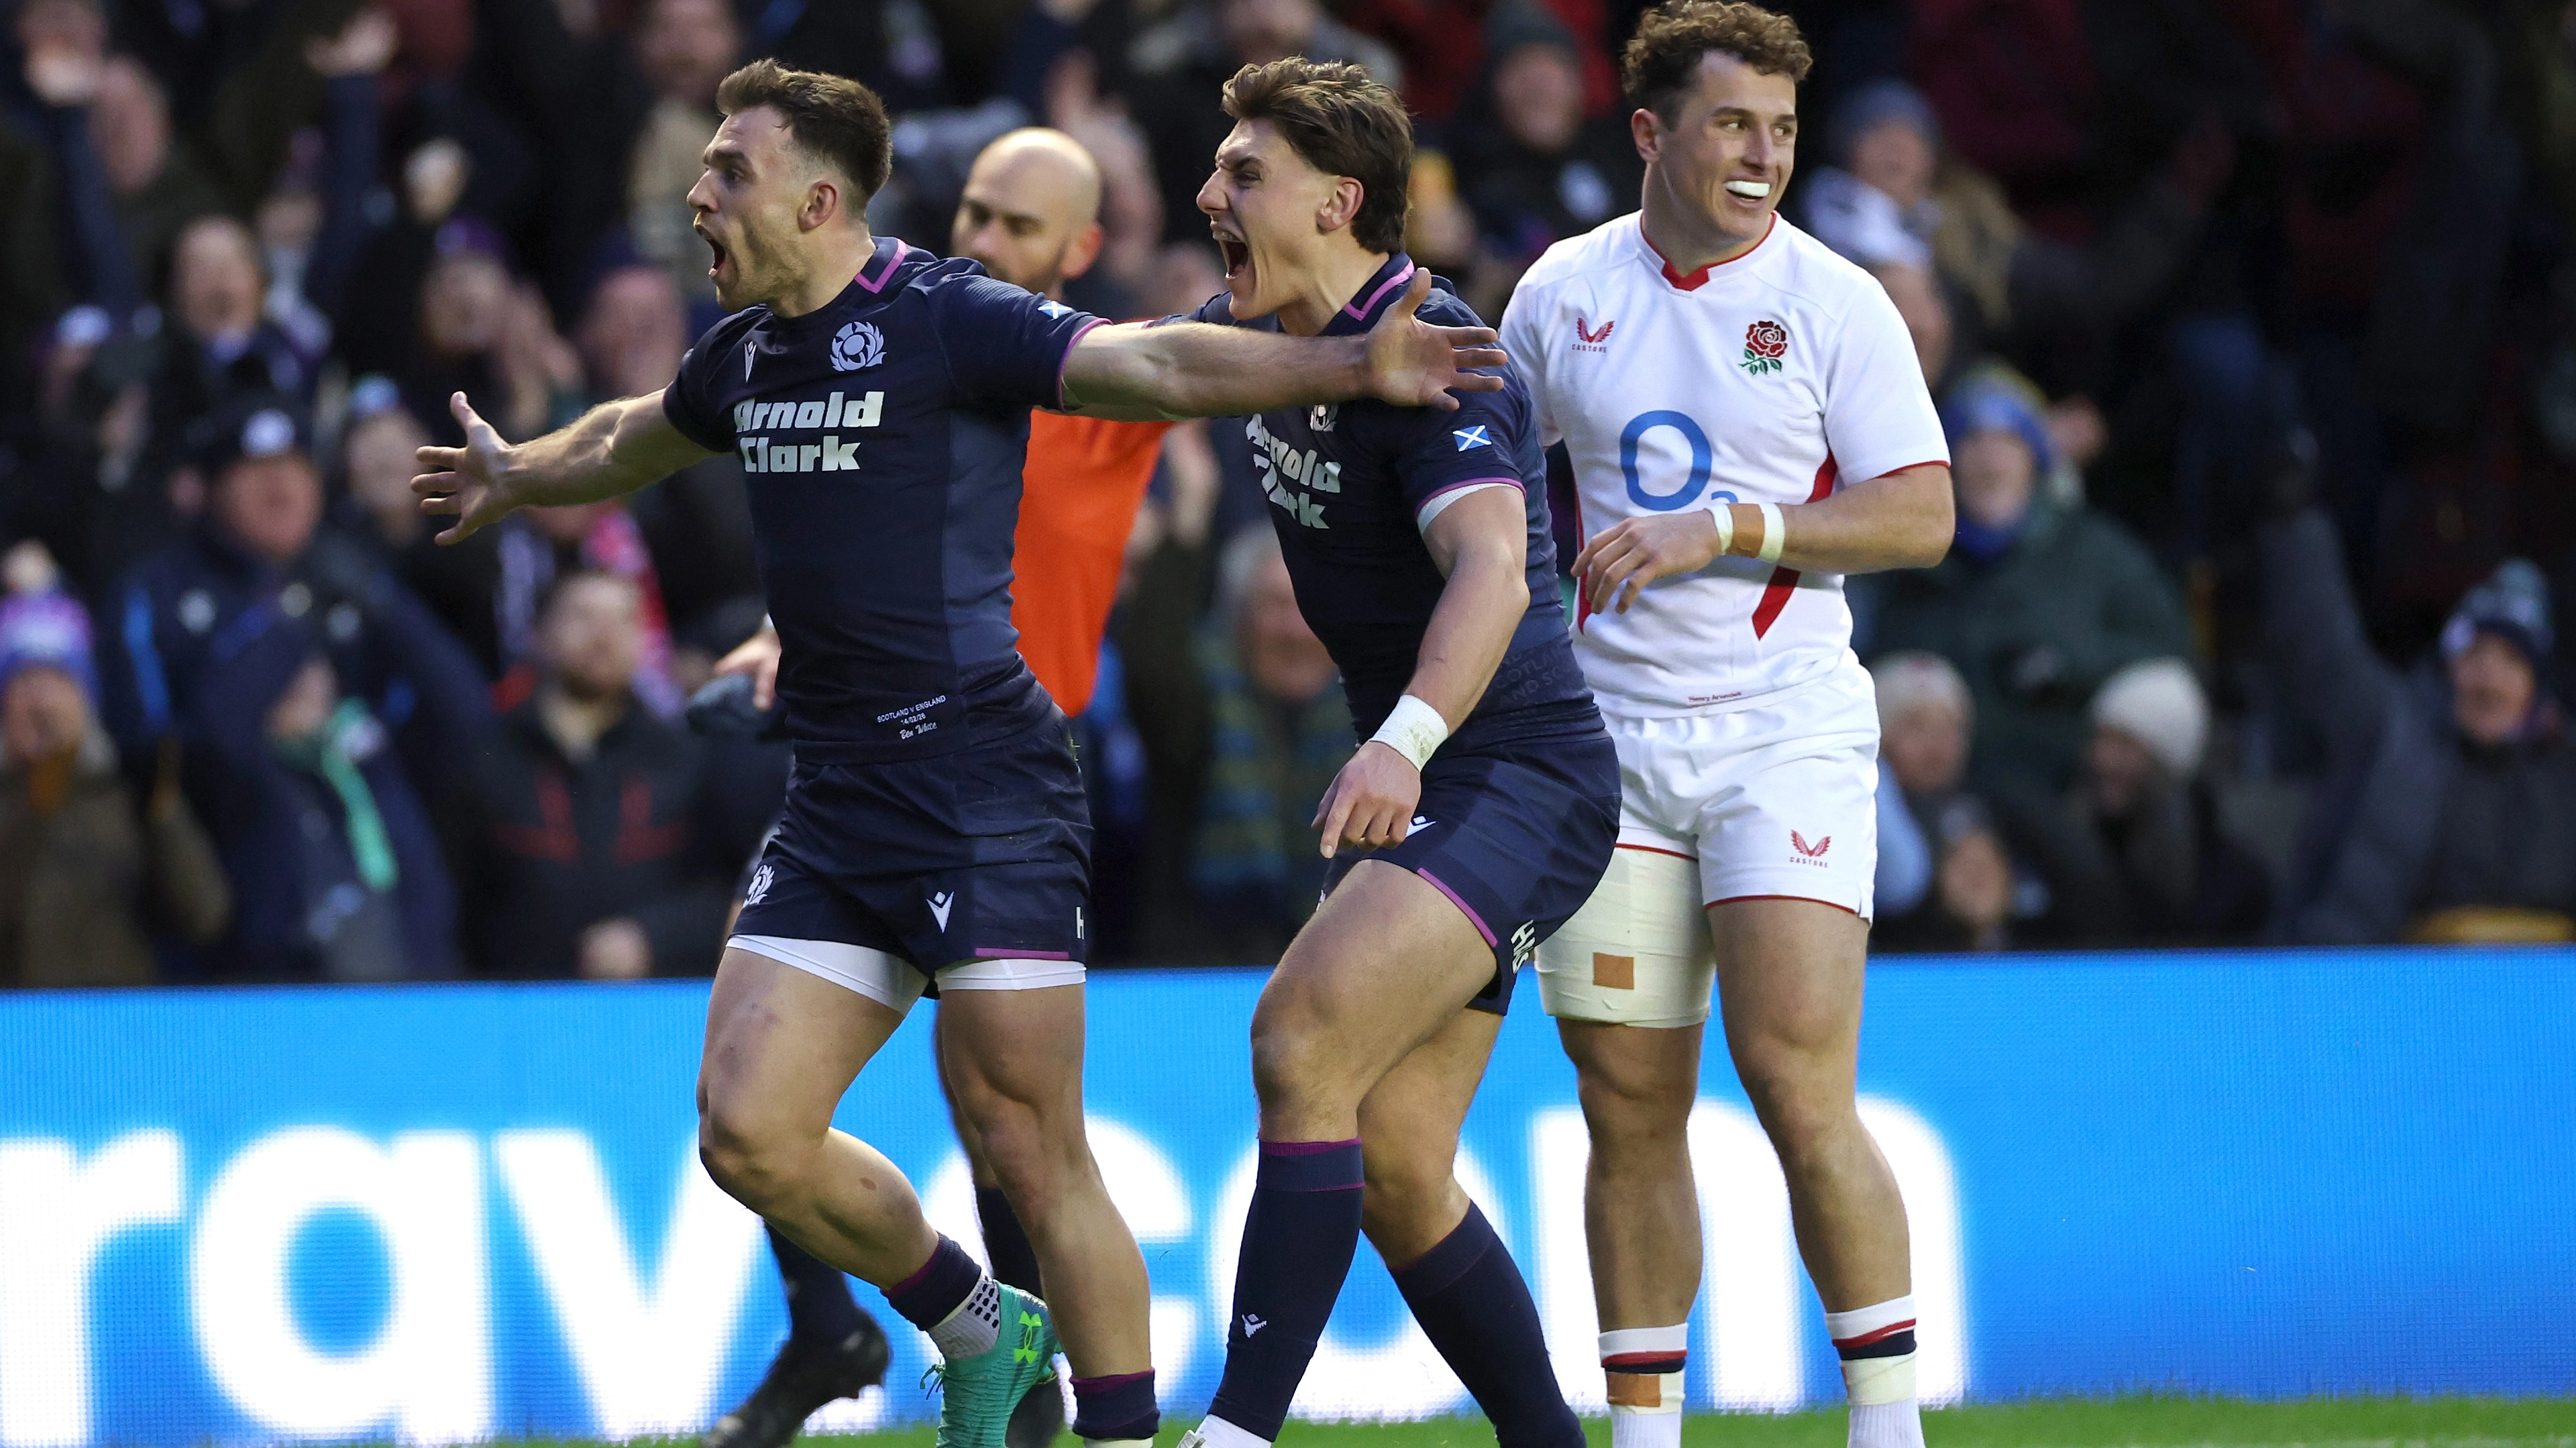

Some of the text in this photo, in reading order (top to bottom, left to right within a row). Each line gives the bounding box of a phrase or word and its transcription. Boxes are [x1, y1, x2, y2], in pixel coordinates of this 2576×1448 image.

[734, 391, 884, 433] Arnold
[740, 435, 861, 473] Clark
[877, 708, 909, 723] SCOTLAND
[915, 695, 946, 711] ENGLAND
